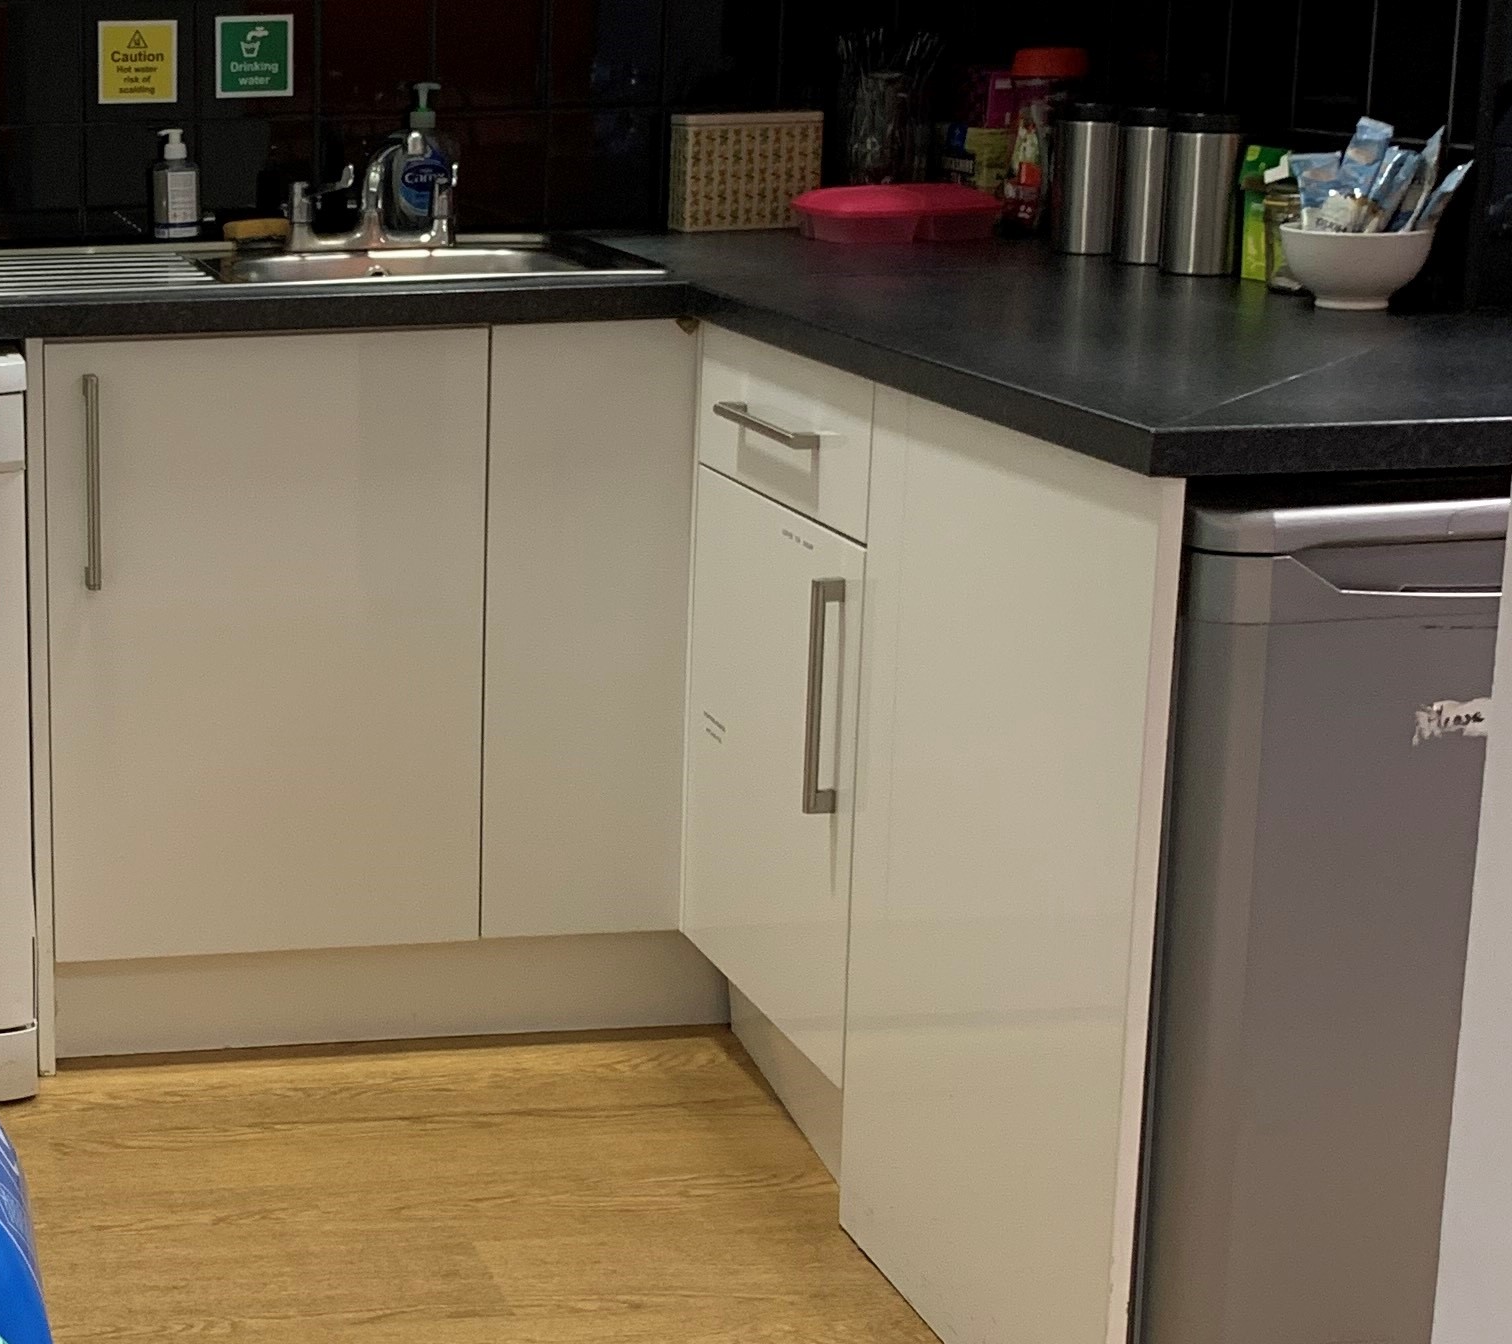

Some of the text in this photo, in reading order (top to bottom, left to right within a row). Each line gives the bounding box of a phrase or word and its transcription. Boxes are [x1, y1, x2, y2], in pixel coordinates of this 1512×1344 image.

[111, 51, 164, 63] Caution
[230, 61, 279, 73] Drinking
[239, 76, 271, 85] water
[119, 86, 155, 95] scalding
